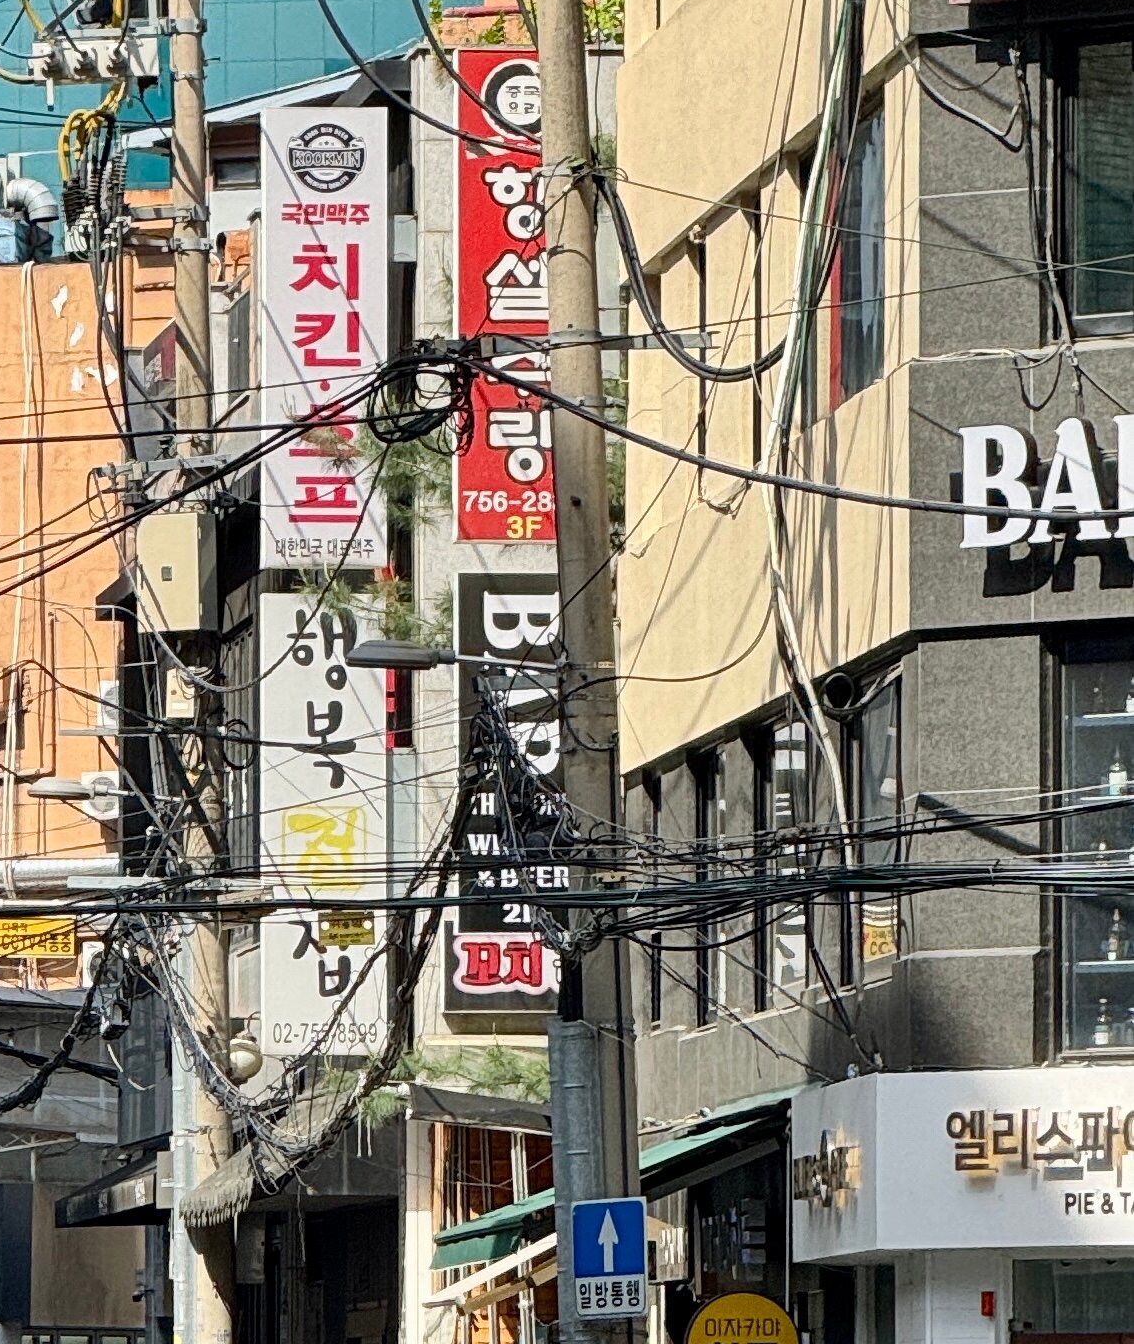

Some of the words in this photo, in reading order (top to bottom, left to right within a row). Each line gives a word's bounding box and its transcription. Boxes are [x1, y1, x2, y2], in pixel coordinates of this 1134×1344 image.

[292, 150, 361, 168] KOOKMIN
[281, 203, 370, 225] 국민맥주
[506, 515, 543, 538] 3F
[275, 537, 323, 559] 대한민국
[1065, 1192, 1094, 1214] PIE
[1101, 1193, 1115, 1214] &
[579, 1279, 641, 1309] 일방통행
[705, 1318, 781, 1338] 이자카야
